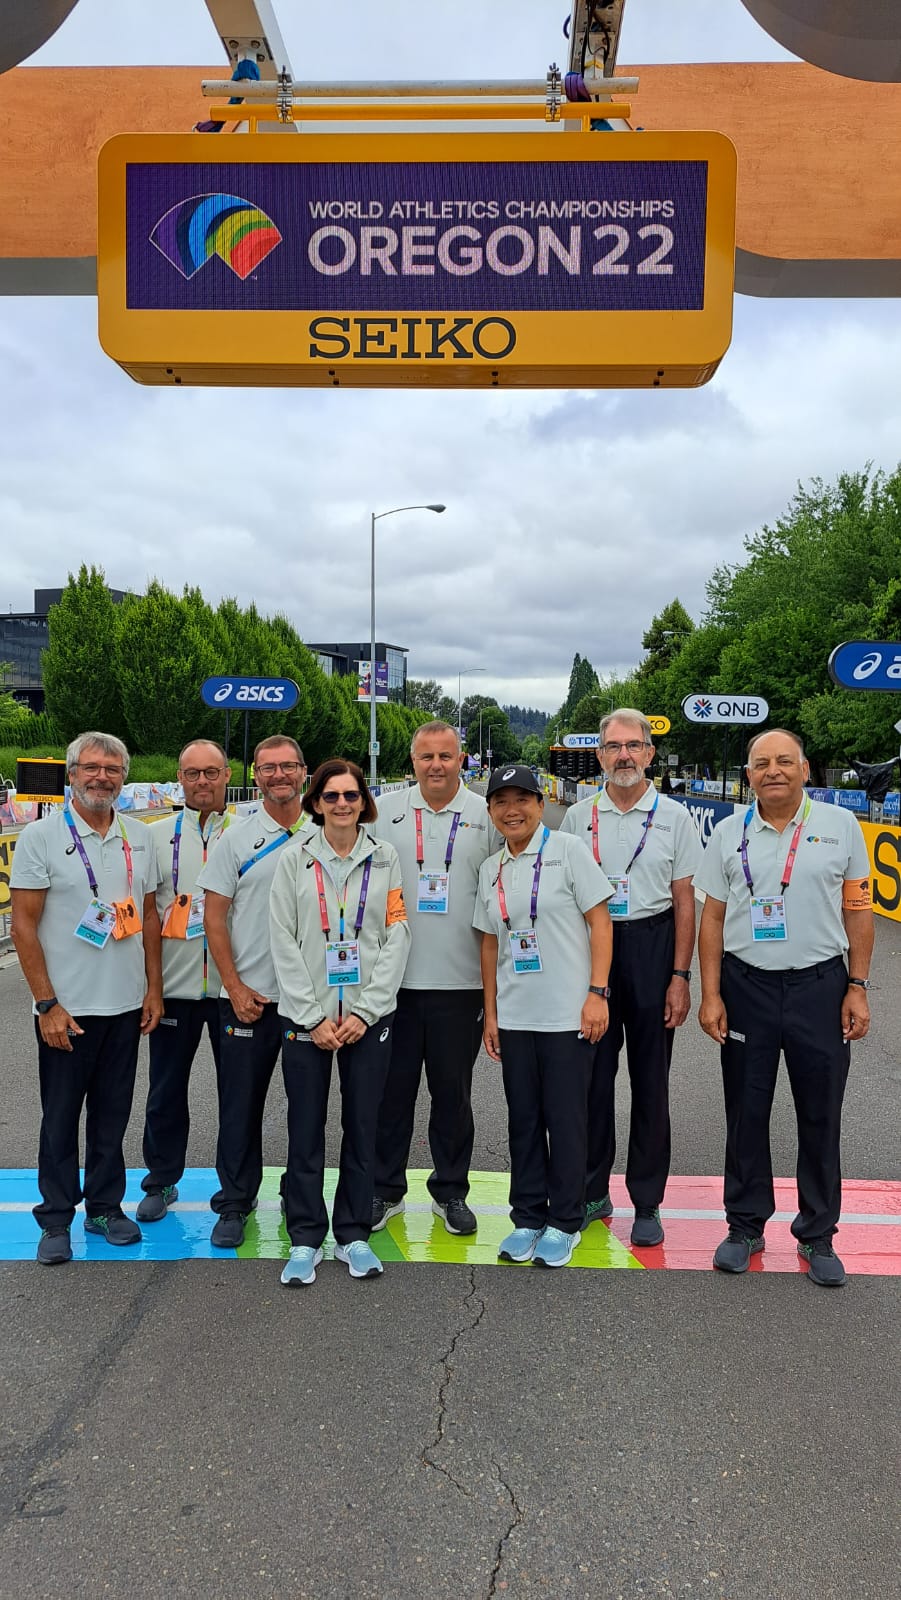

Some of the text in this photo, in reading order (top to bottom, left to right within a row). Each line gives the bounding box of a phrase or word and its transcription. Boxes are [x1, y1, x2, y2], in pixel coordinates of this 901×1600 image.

[309, 200, 674, 219] WORLD ATHLETICS CHAMPIONSHIPS
[309, 316, 517, 359] SEIKO
[717, 702, 760, 717] QNB
